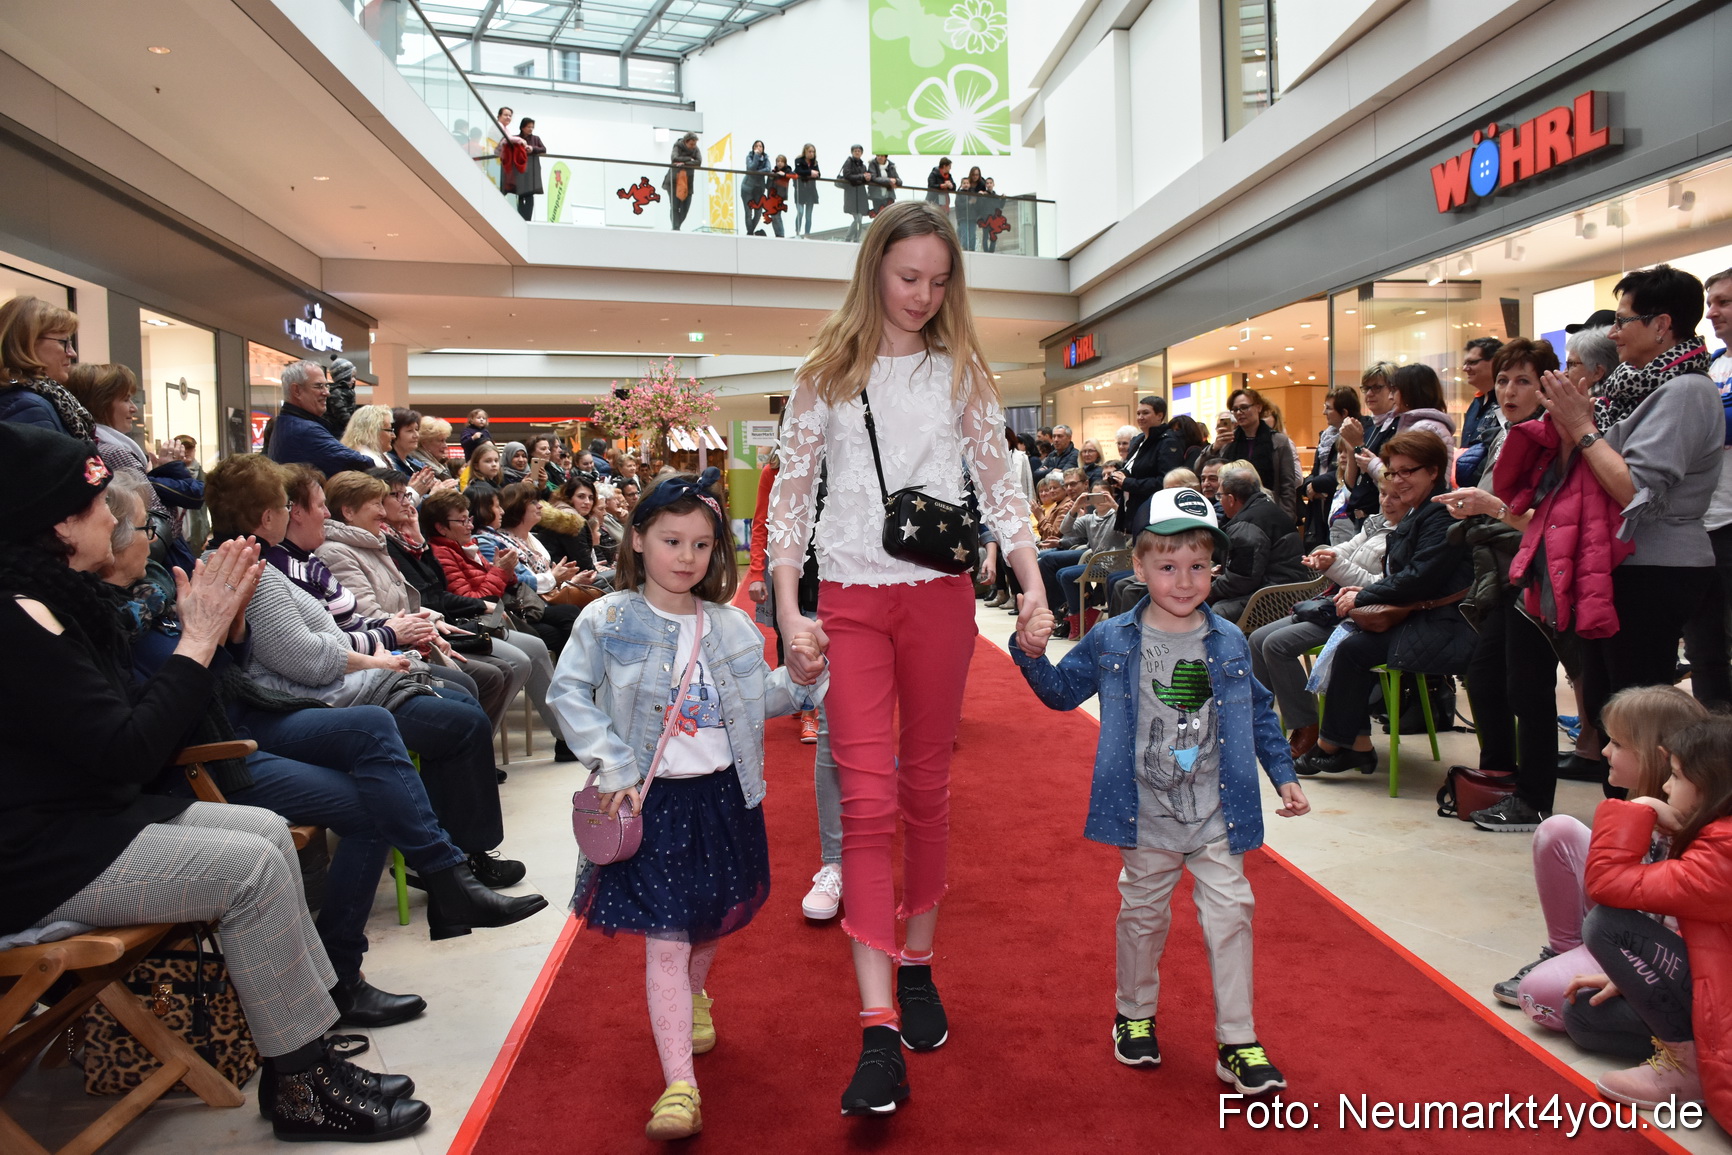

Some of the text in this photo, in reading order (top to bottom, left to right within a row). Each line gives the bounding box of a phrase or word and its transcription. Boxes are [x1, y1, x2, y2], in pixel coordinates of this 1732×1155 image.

[1430, 90, 1610, 214] WÖHRL
[1063, 333, 1096, 369] WÖHRL
[934, 501, 953, 511] GUESS
[1651, 942, 1683, 980] THE
